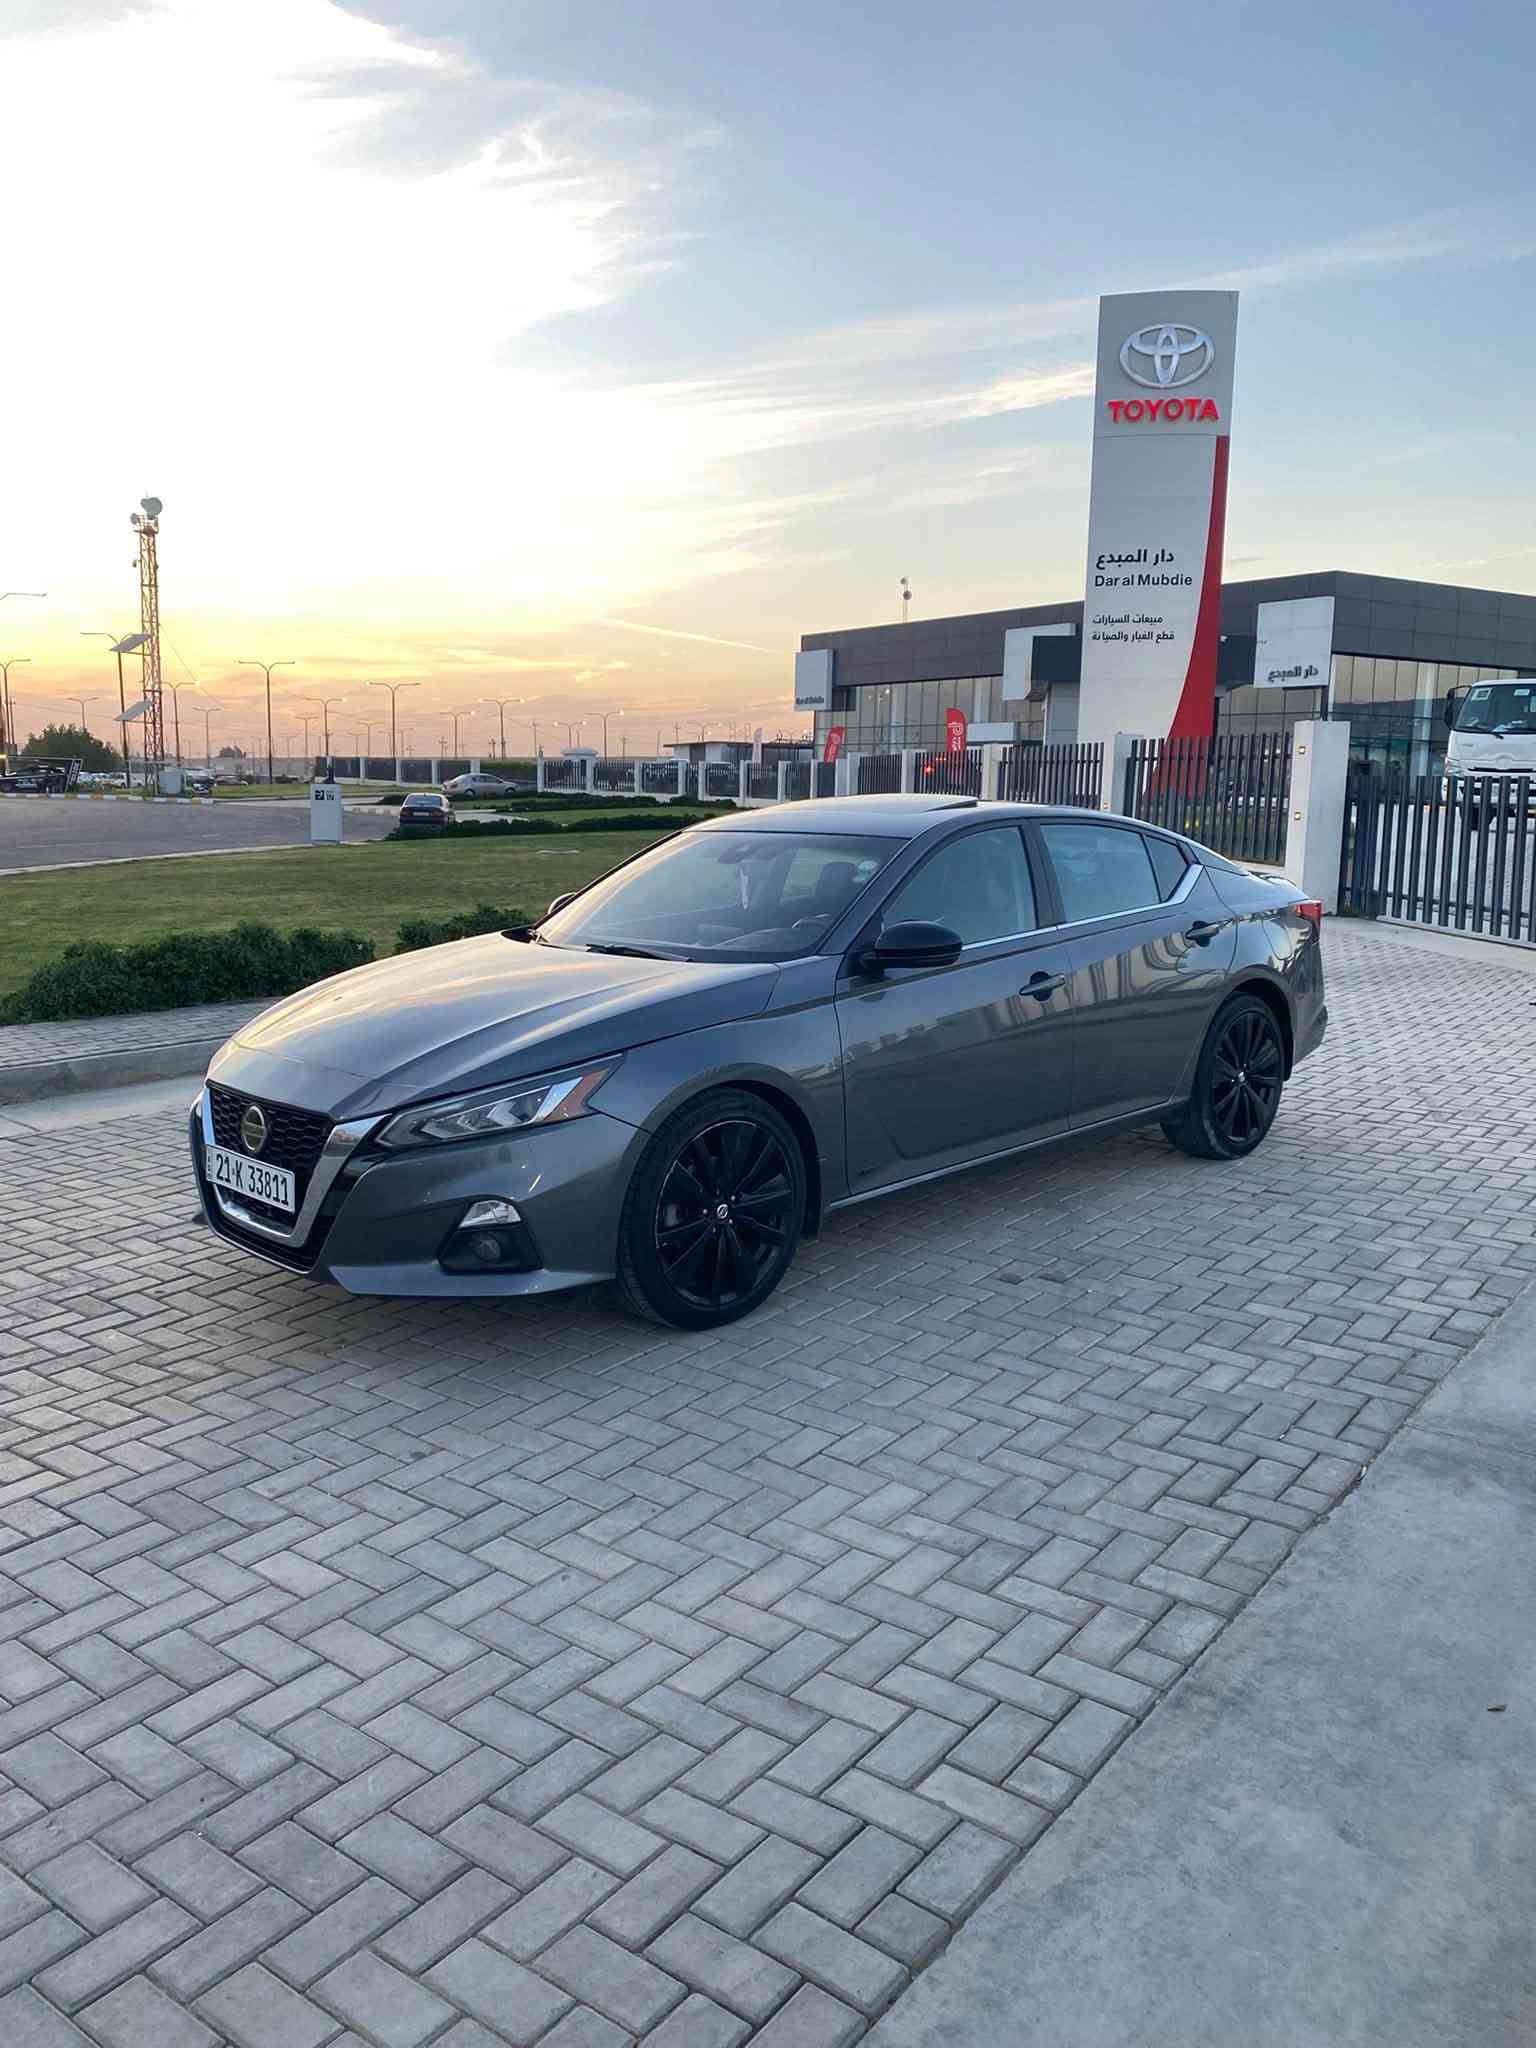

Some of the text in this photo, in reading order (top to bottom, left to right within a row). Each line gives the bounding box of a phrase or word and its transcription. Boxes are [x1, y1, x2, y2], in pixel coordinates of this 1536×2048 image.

[1108, 397, 1219, 423] TOYOTA
[1095, 548, 1175, 570] دار المبدع
[1095, 573, 1193, 587] Dar al Mubdie
[1092, 614, 1164, 626] مبيعات السيارات
[1155, 630, 1175, 644] قطع
[247, 1164, 289, 1206] 33811
